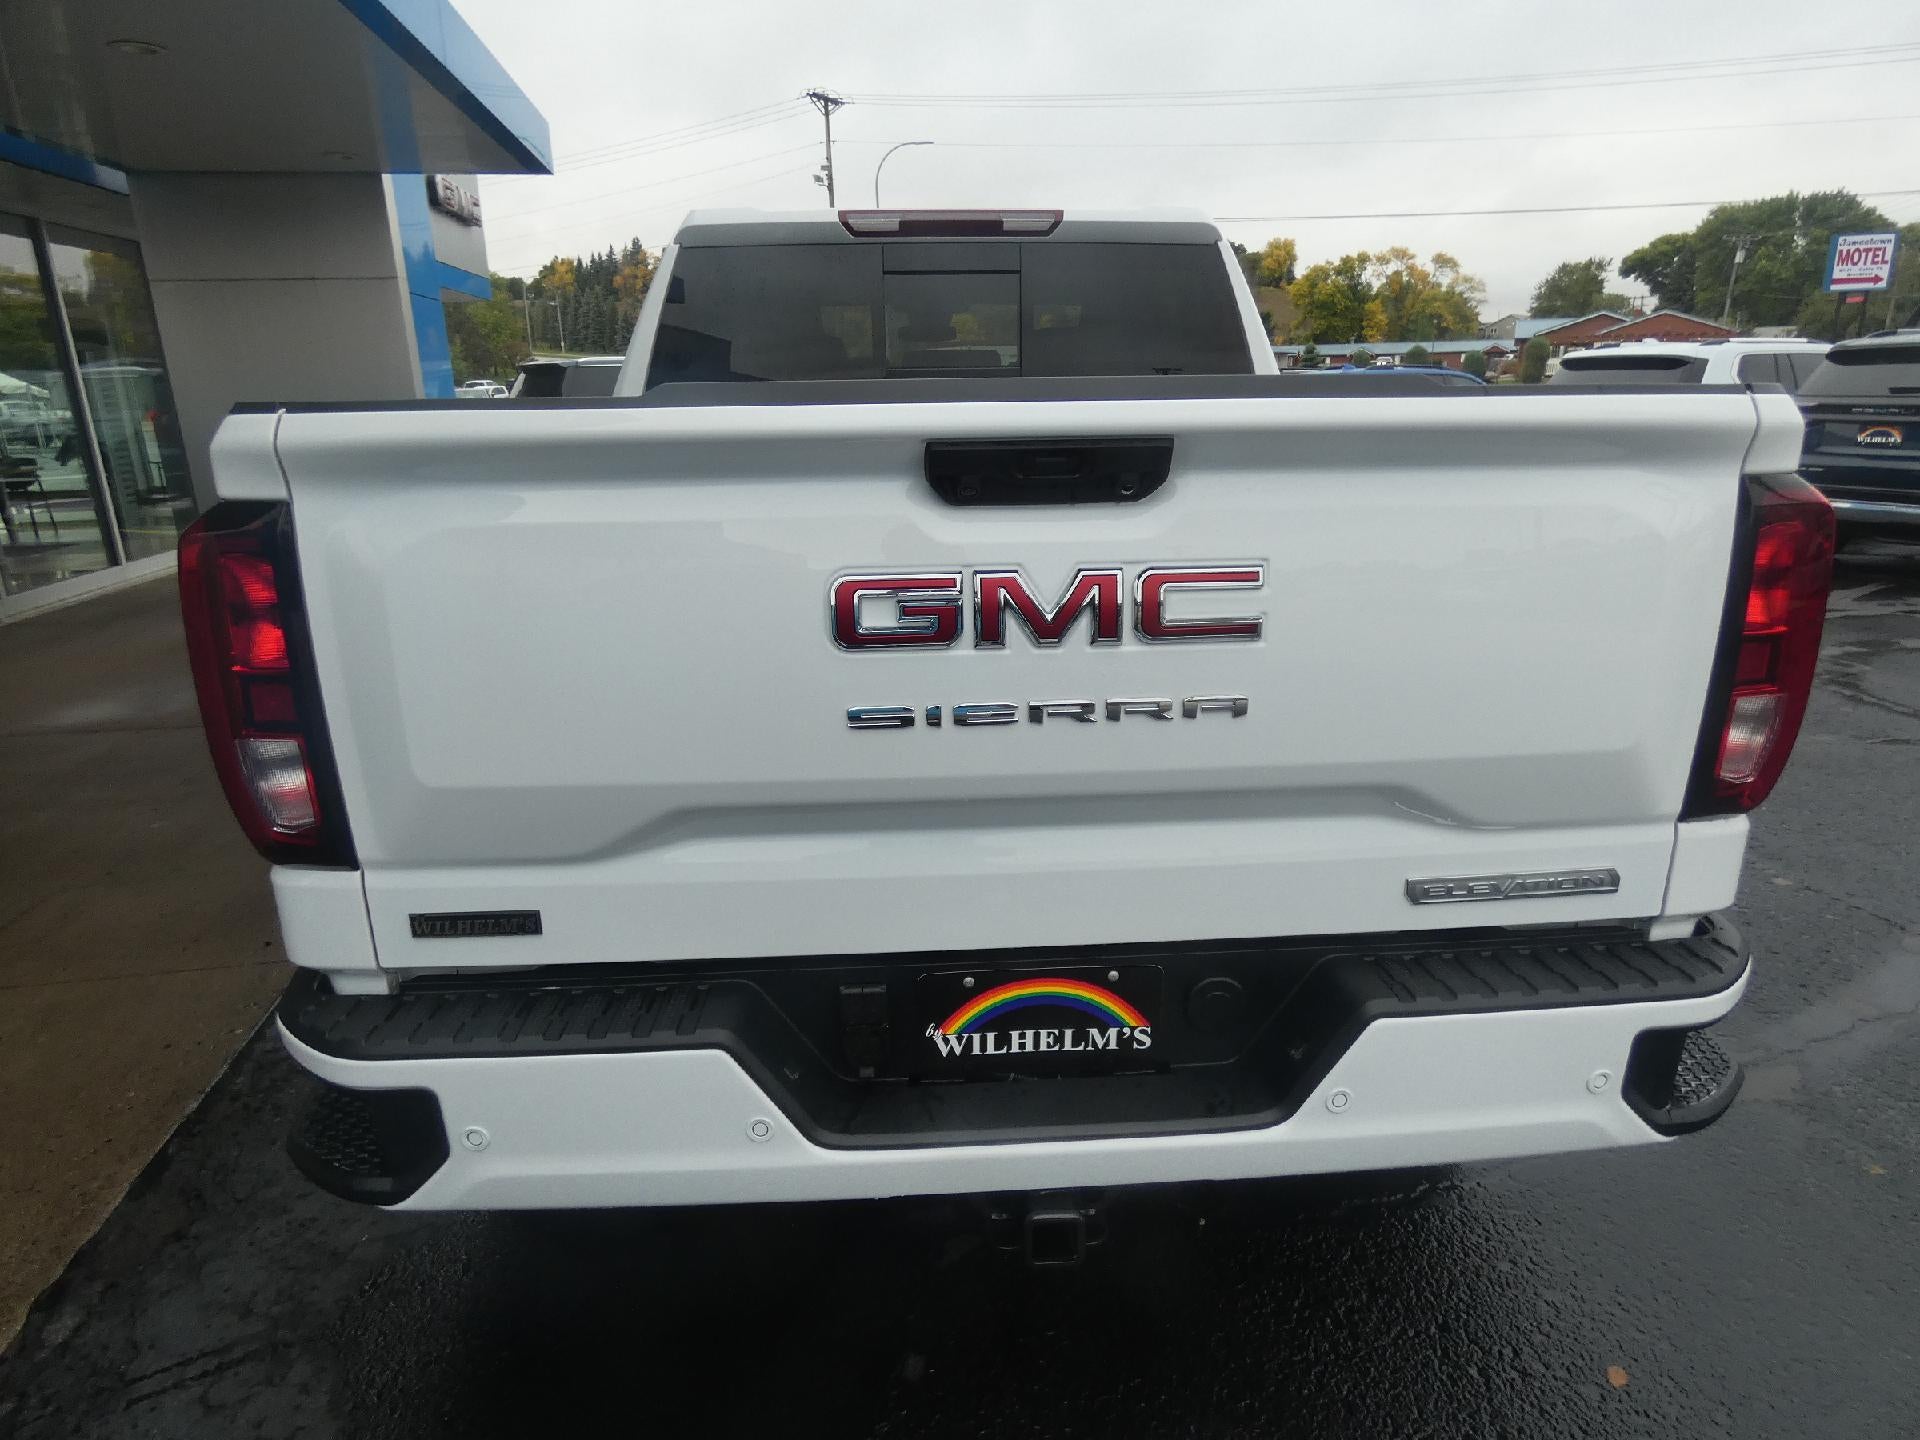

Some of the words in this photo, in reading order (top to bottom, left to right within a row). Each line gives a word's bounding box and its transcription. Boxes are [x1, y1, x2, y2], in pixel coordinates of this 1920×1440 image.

[1837, 247, 1889, 267] MOTEL
[830, 565, 1265, 652] GMC
[846, 694, 1249, 729] SIERRA
[1423, 874, 1607, 897] ELEVATION
[412, 917, 538, 935] WILHELM'S
[925, 1022, 944, 1042] by
[935, 1026, 1152, 1058] WILHELM'S
